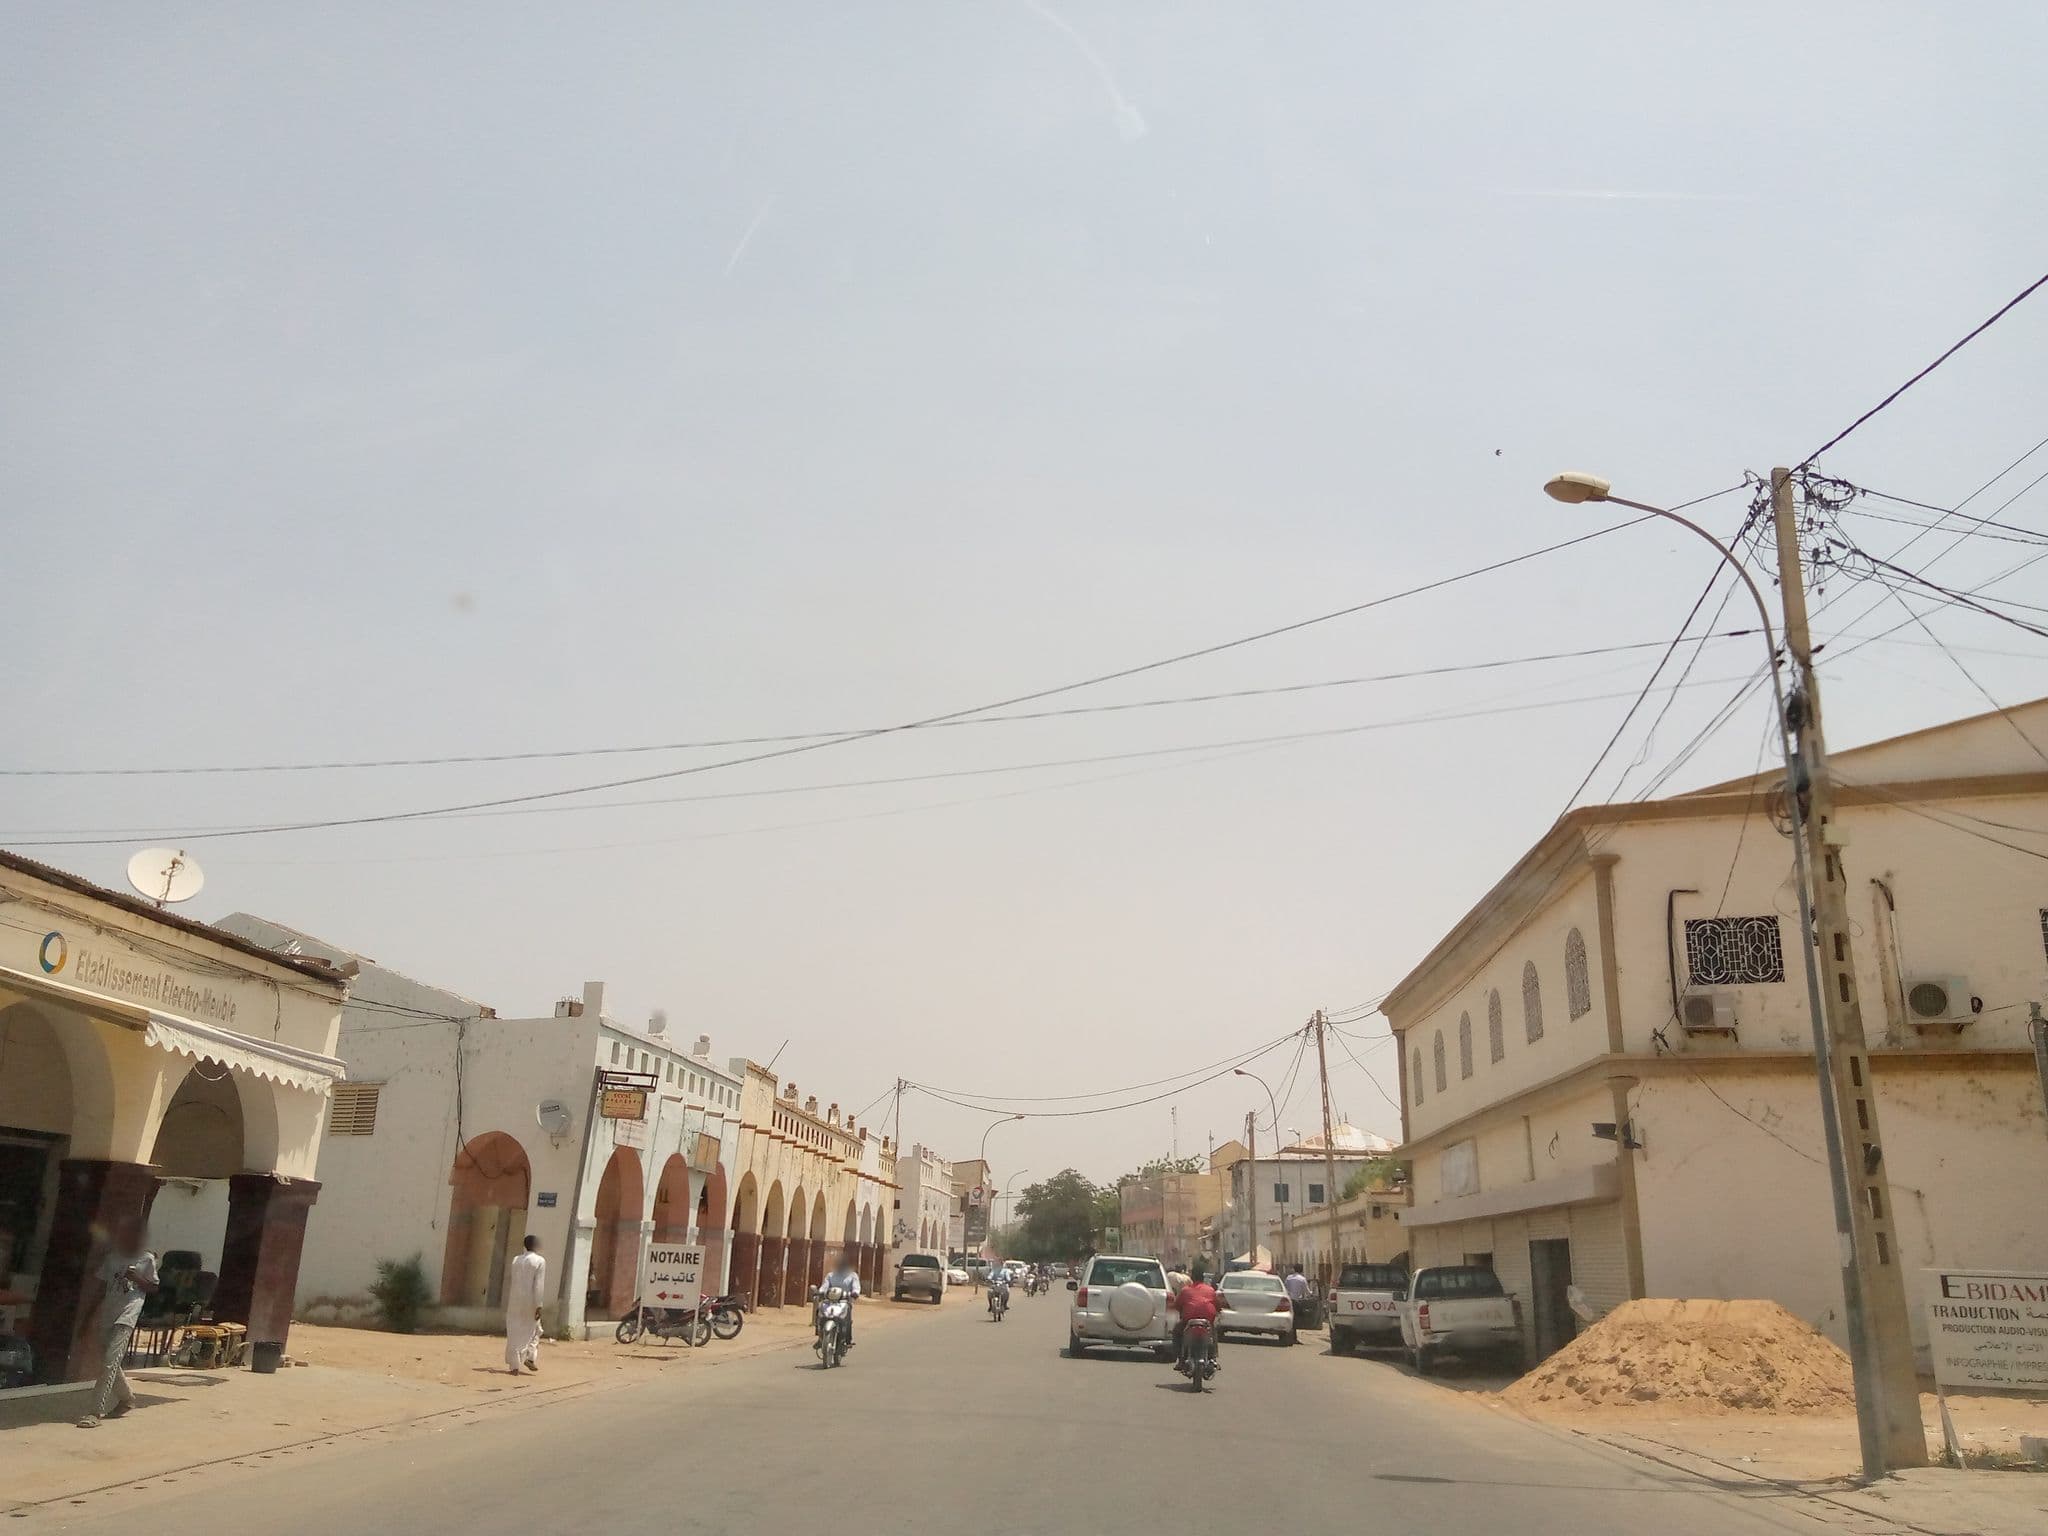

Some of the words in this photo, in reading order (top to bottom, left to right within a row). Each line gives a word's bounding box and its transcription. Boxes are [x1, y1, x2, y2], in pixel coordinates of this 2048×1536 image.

[75, 949, 161, 1001] Etablissement
[160, 973, 237, 1023] Electro-Meuble
[650, 1250, 700, 1265] NOTAIRE
[650, 1271, 670, 1284] عدل
[672, 1272, 697, 1285] كاتب
[1940, 1274, 2048, 1302] EBIDAM
[1347, 1300, 1397, 1312] TOYOTA
[1932, 1304, 2020, 1321] TRADUCTION
[1942, 1323, 1997, 1335] PRODUCTION
